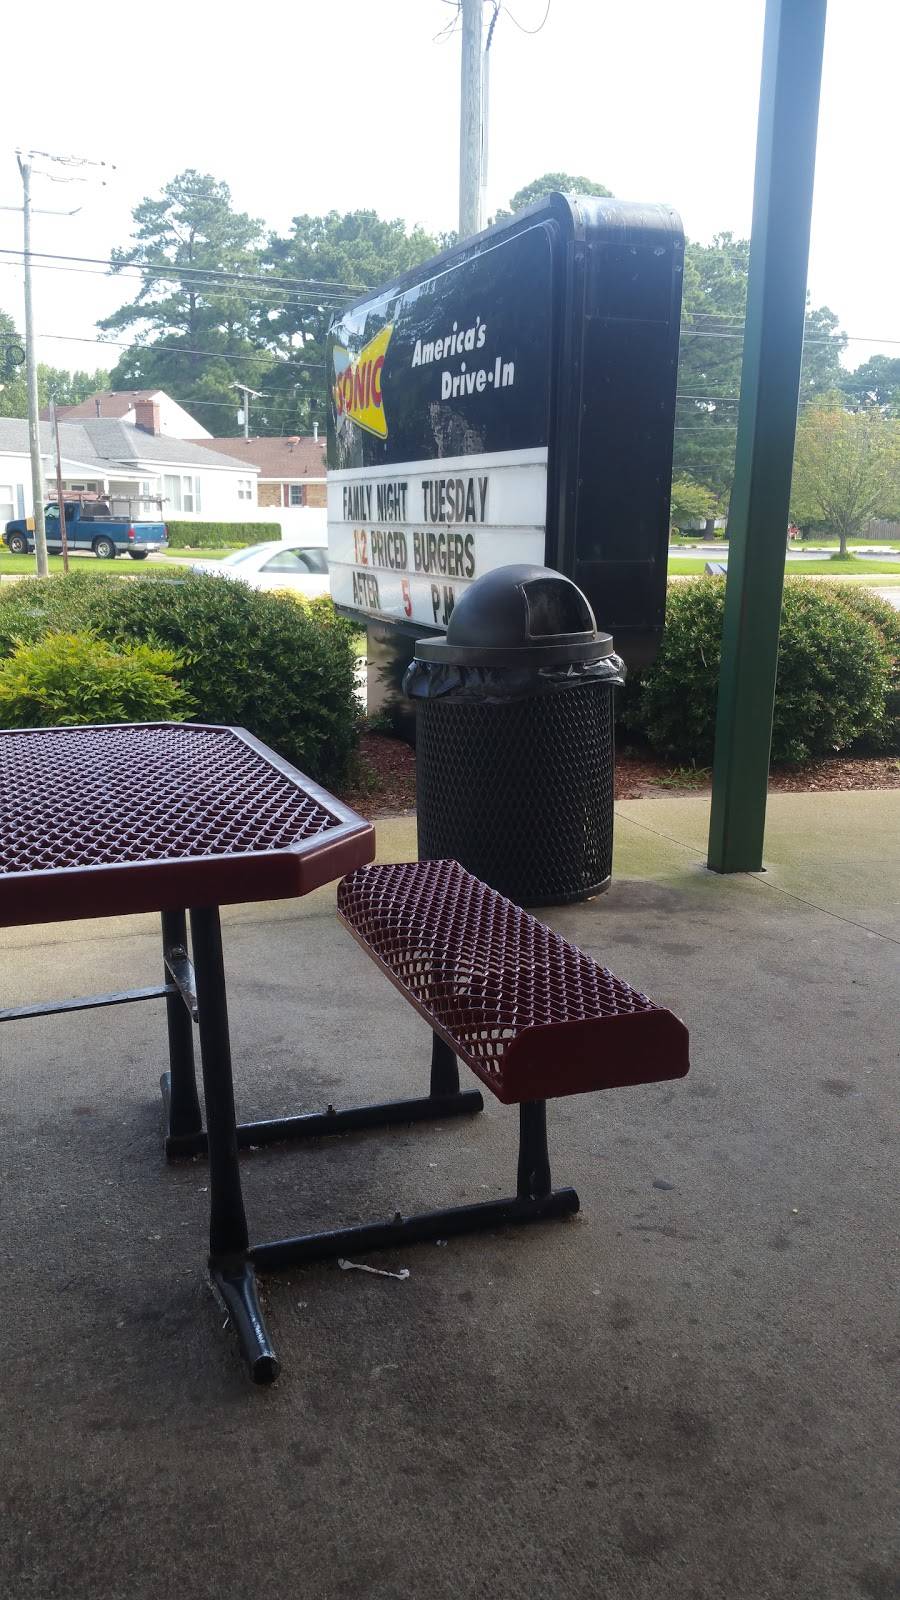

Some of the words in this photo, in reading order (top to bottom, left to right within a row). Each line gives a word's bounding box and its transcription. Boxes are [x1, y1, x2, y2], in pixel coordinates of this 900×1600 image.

[412, 316, 487, 367] America's
[335, 355, 385, 416] SONIC
[343, 485, 372, 521] FAMILY
[377, 482, 408, 521] NIGHT
[422, 477, 488, 523] TUESDAY
[371, 530, 407, 569] PRICED
[413, 532, 475, 578] BURGERS
[352, 571, 381, 610] AFTER
[401, 577, 412, 617] 5
